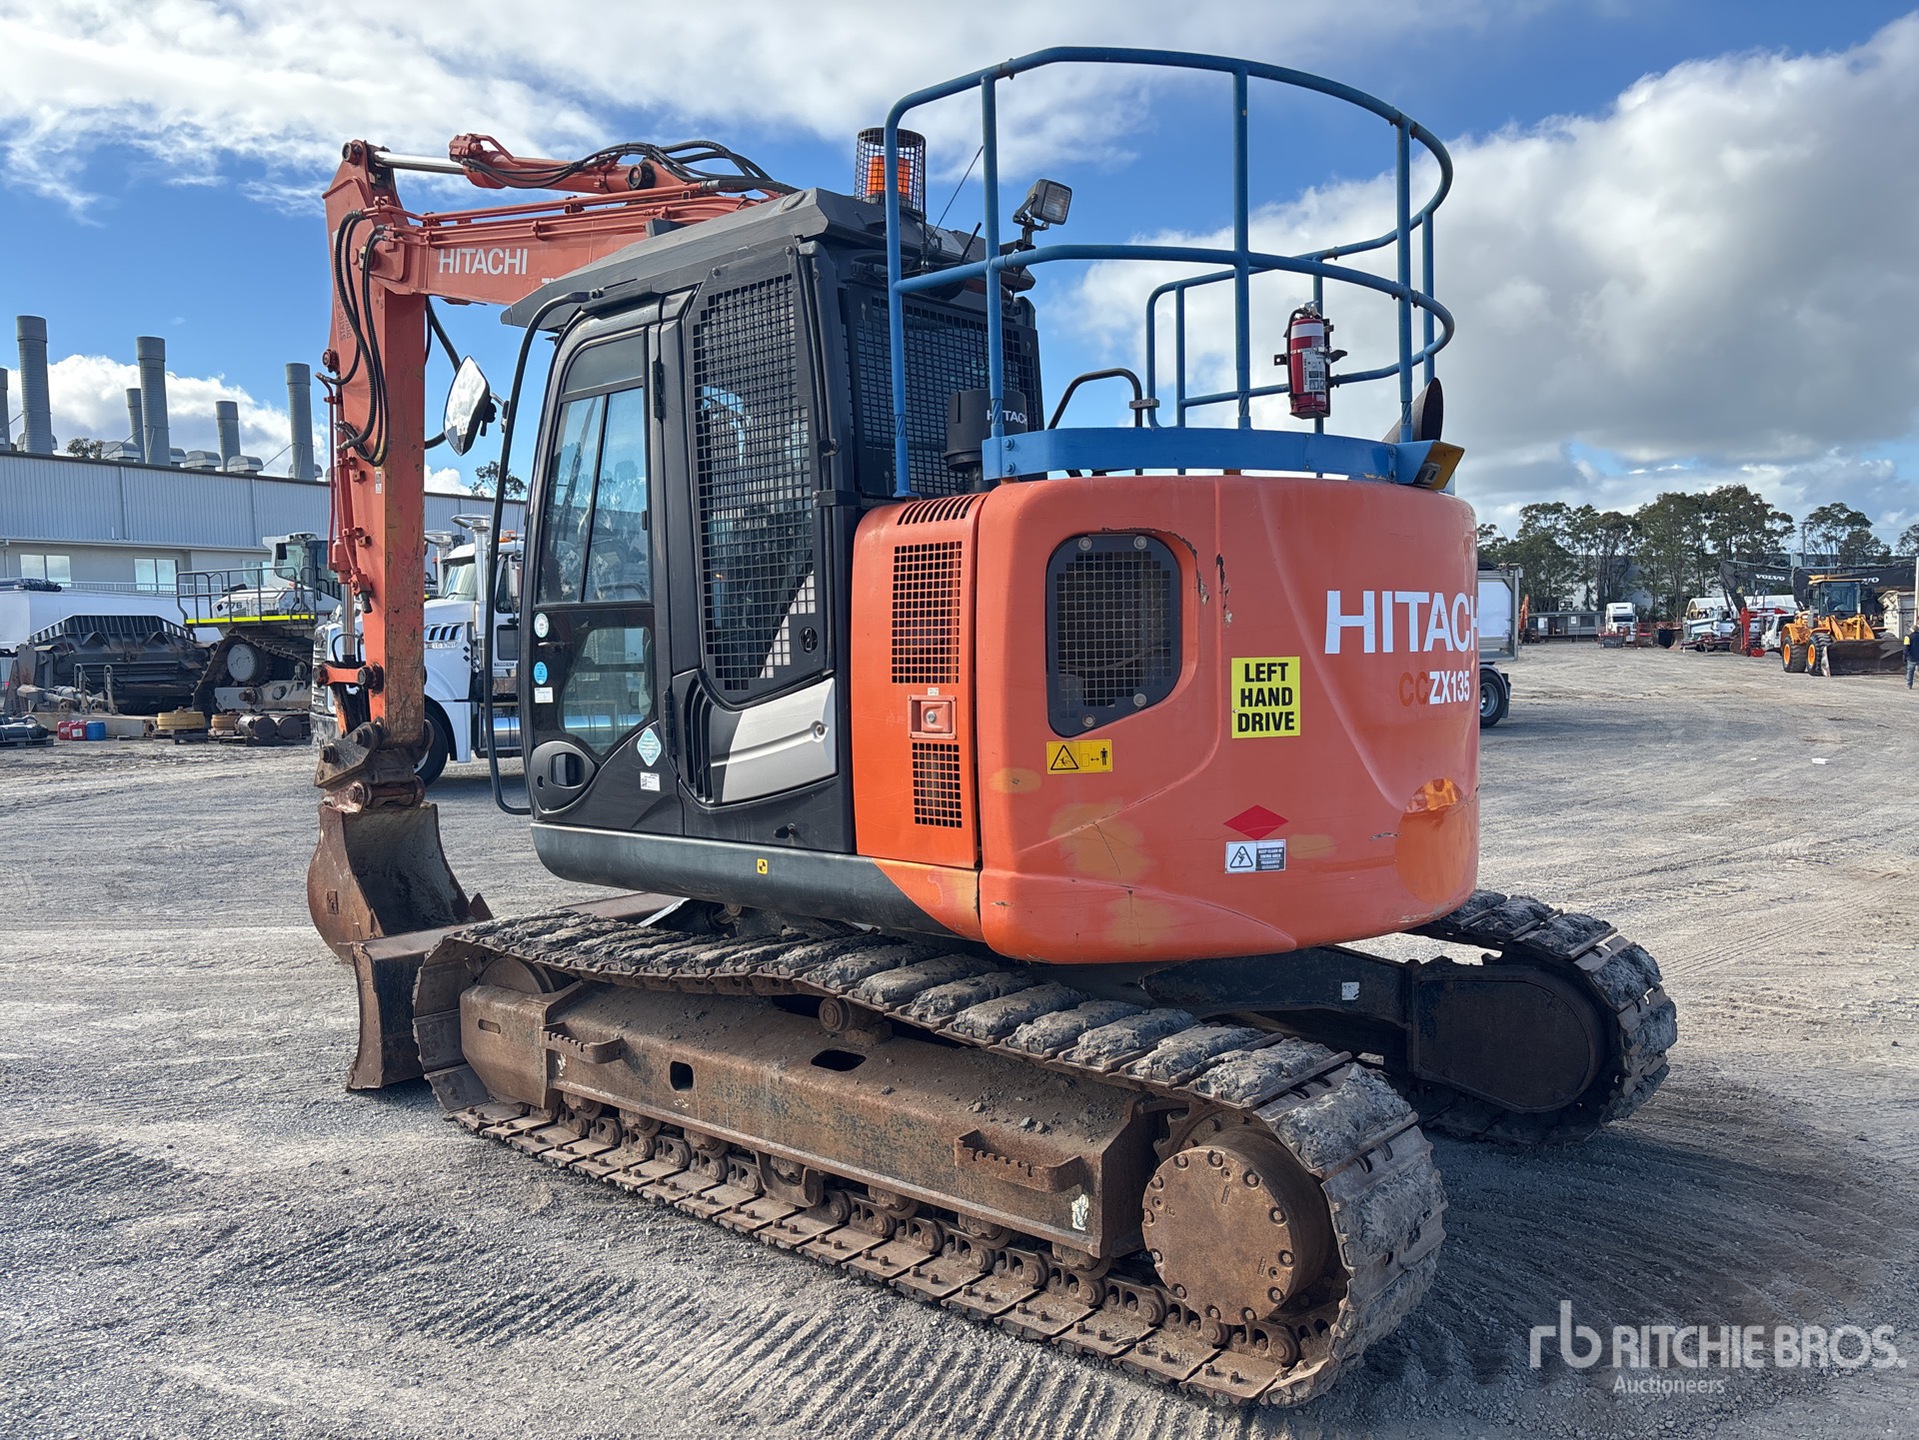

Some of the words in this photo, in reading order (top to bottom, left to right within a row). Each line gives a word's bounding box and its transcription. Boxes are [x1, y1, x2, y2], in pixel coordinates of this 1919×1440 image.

[438, 247, 528, 275] HITACHI
[986, 409, 1027, 425] HTAC
[1755, 573, 1786, 581] VOLVO
[1324, 590, 1478, 655] HITACH
[1243, 662, 1289, 683] LEFT
[1240, 686, 1293, 708] HAND
[1429, 670, 1470, 705] ZX135
[1237, 711, 1295, 733] DRIVE
